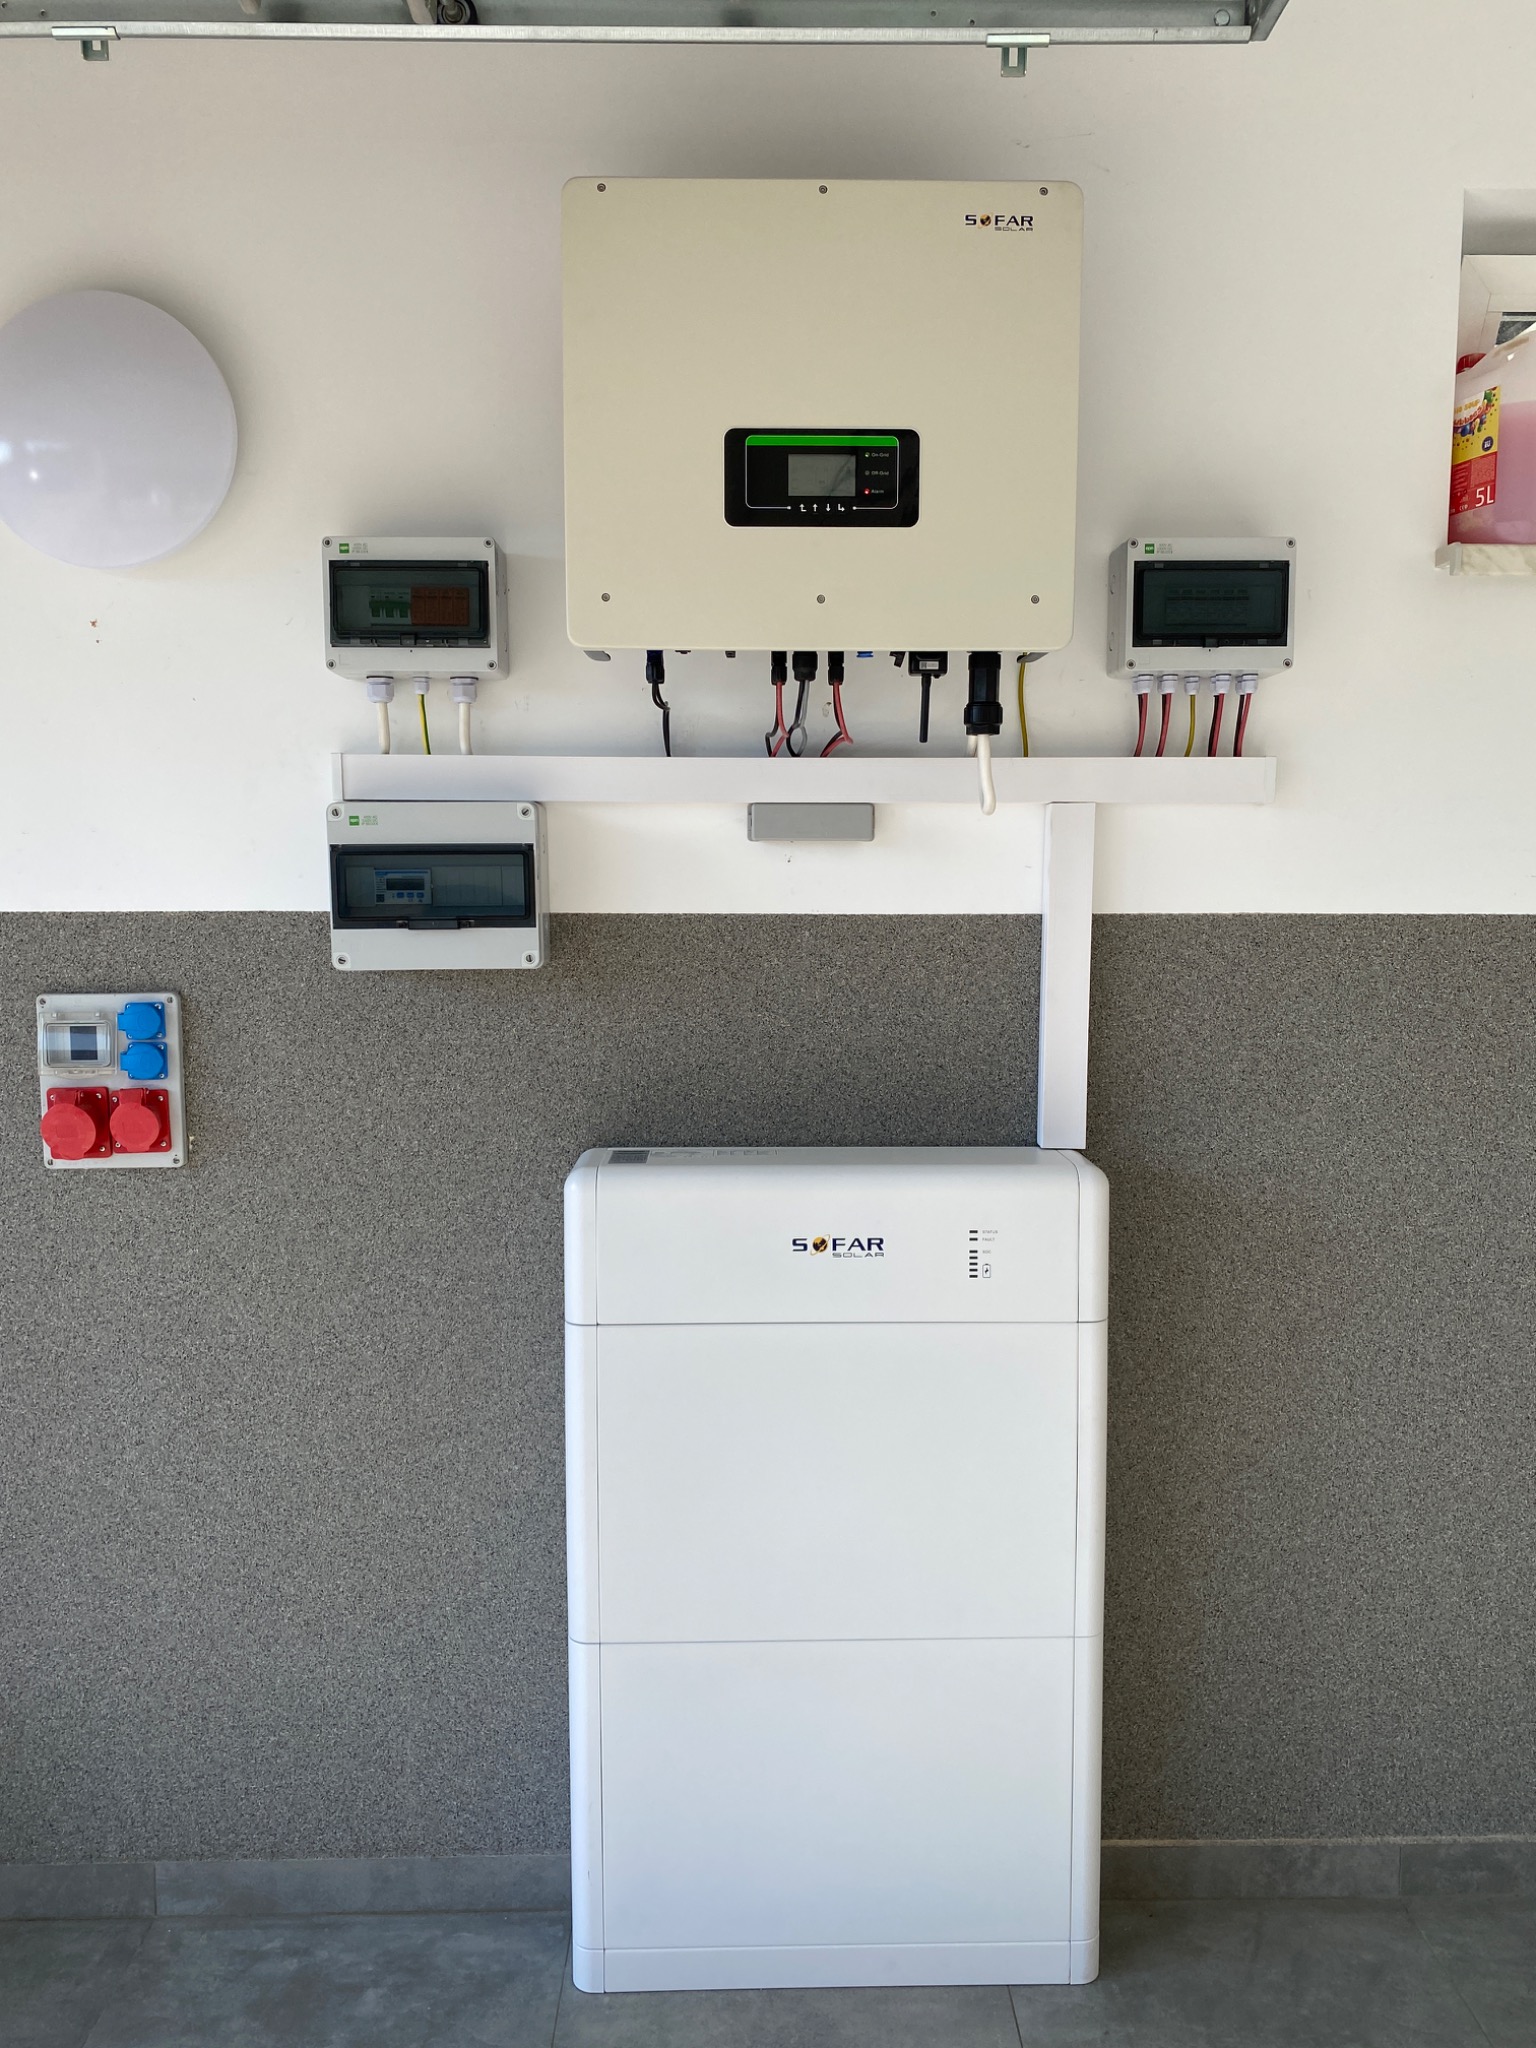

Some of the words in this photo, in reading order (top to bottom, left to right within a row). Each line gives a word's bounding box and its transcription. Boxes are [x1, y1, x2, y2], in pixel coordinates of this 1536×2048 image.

[965, 214, 1034, 227] SOFAR
[1475, 485, 1494, 507] 5L
[791, 1236, 885, 1252] SOFAR
[832, 1251, 885, 1259] SOLAR
